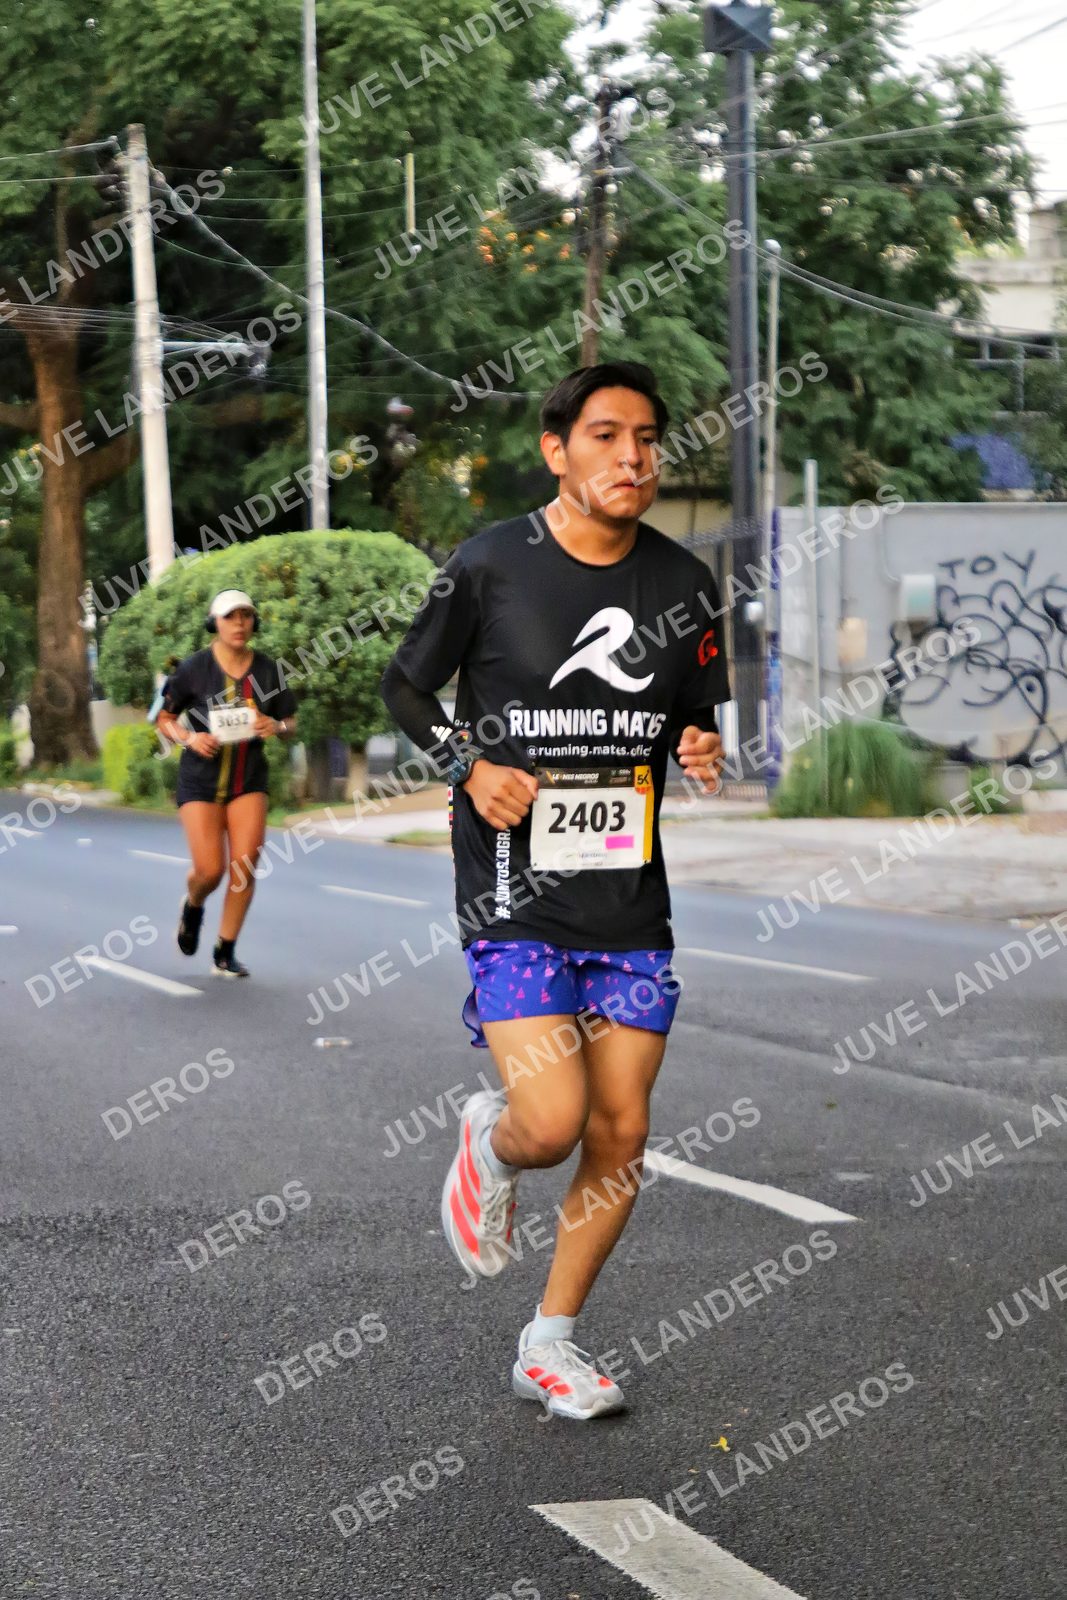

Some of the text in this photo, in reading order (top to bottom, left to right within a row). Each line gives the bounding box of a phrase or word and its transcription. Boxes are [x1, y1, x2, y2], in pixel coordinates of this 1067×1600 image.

[938, 549, 1036, 587] TOY
[510, 709, 607, 737] RUNNING
[548, 800, 626, 834] 2403
